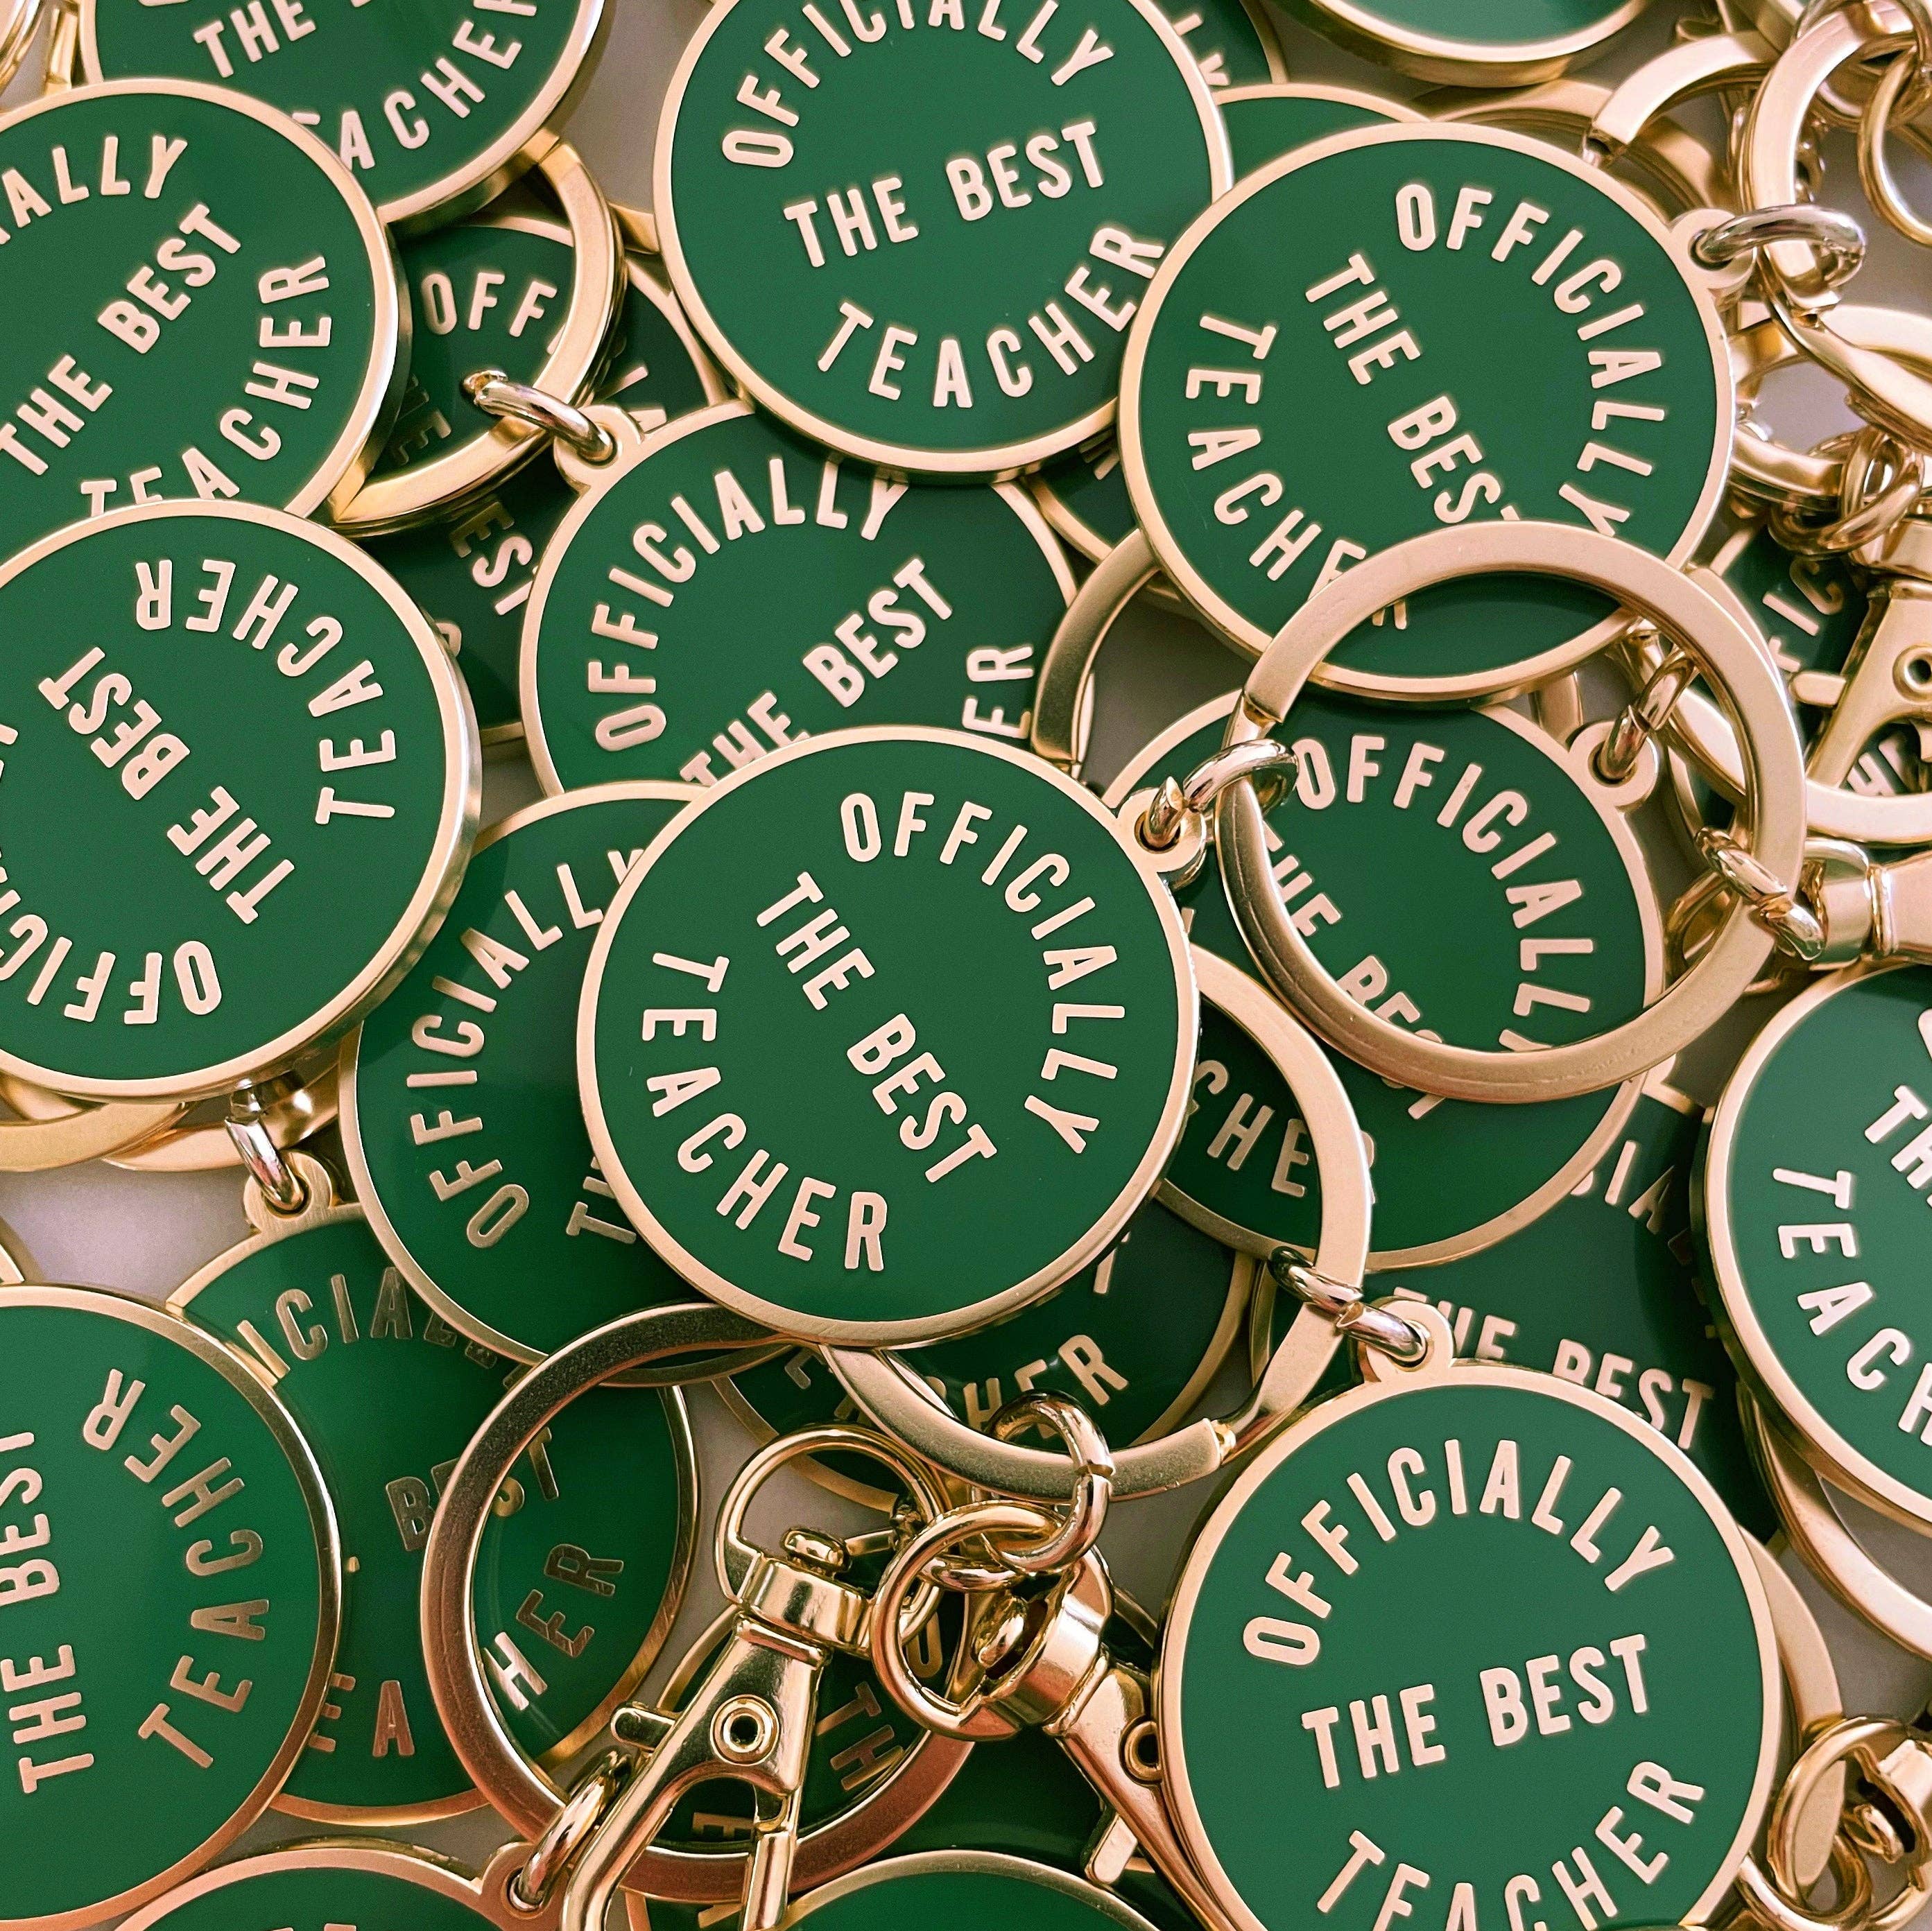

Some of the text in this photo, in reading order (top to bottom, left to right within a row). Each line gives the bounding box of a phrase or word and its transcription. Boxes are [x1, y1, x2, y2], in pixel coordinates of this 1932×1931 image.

[784, 121, 1105, 268] THE BEST
[818, 223, 1166, 408] TEACHER
[0, 202, 241, 475] THE BEST
[1306, 254, 1520, 523] THE BES
[1395, 183, 1666, 535] OFFICIALLY
[137, 559, 396, 824] TEACHER
[588, 456, 909, 752] OFFICIALLY
[802, 558, 952, 707] BEST
[38, 646, 295, 924] THE BEST
[757, 872, 997, 1182] THE BEST
[840, 791, 1125, 1154] OFFICIALLY
[643, 952, 888, 1272] TEACHER
[83, 1368, 269, 1768] TEACHER
[1243, 1439, 1675, 1665] OFFICIALLY
[1, 1644, 94, 1794] THE
[1301, 1634, 1650, 1789] THE BEST
